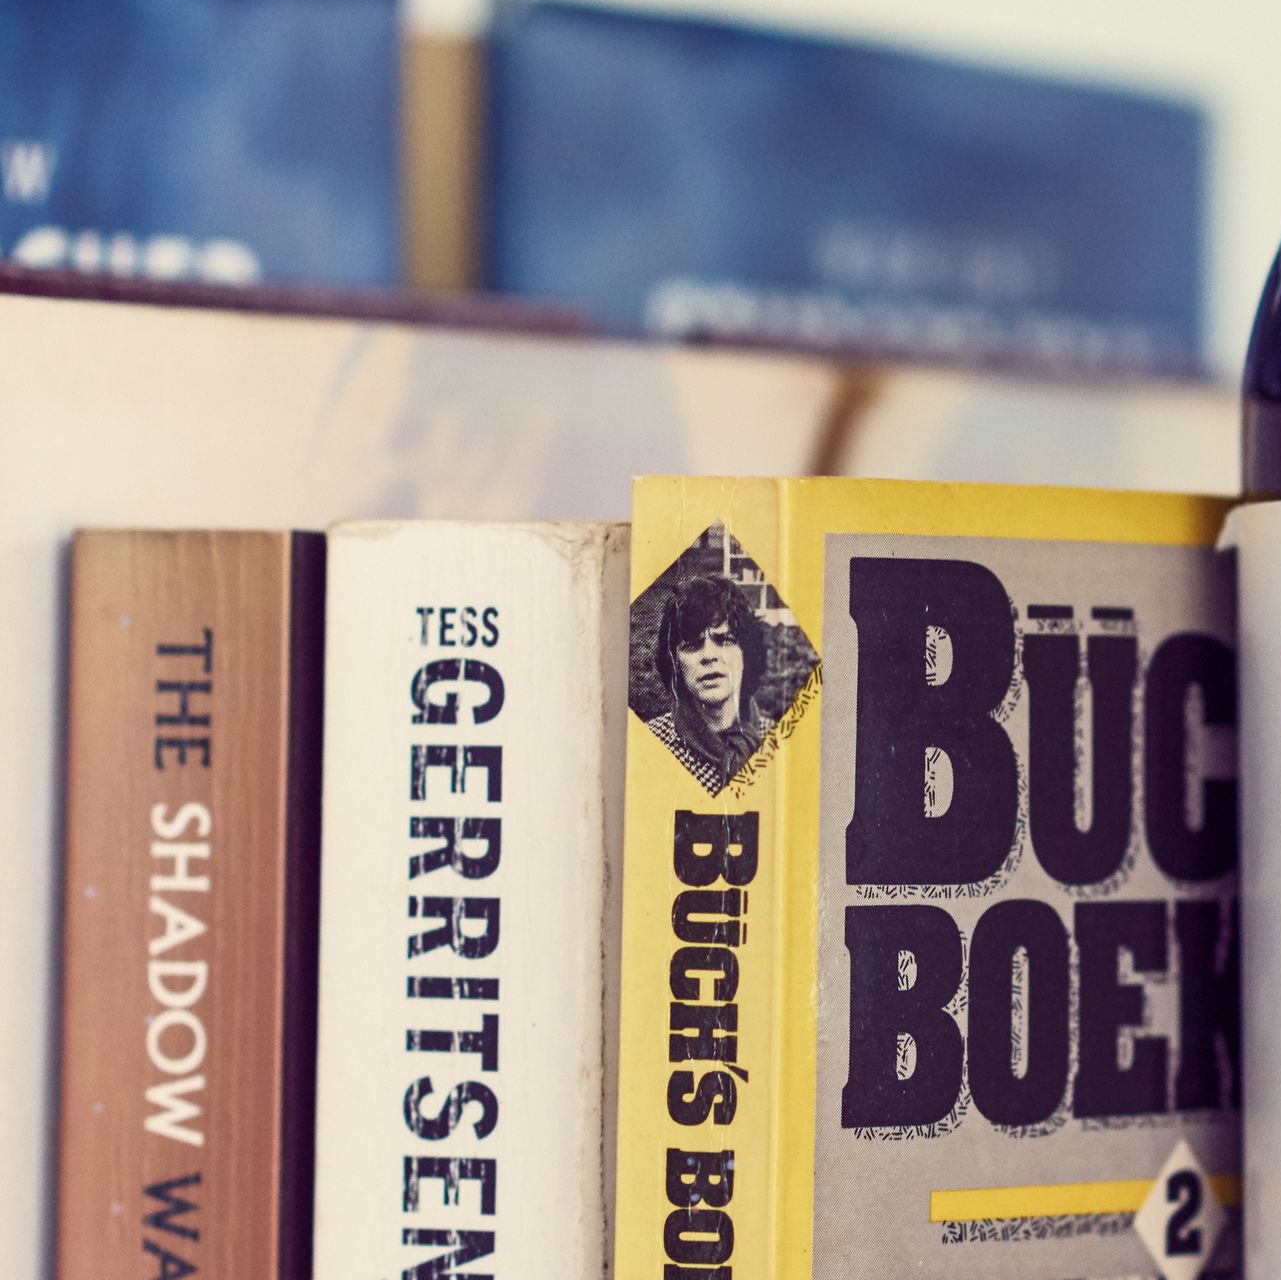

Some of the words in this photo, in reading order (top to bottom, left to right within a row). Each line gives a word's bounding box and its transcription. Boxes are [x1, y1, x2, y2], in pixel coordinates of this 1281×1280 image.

[417, 606, 500, 649] TESS
[155, 626, 213, 770] THE
[144, 802, 212, 1147] SHADOW
[1164, 1169, 1201, 1258] 2
